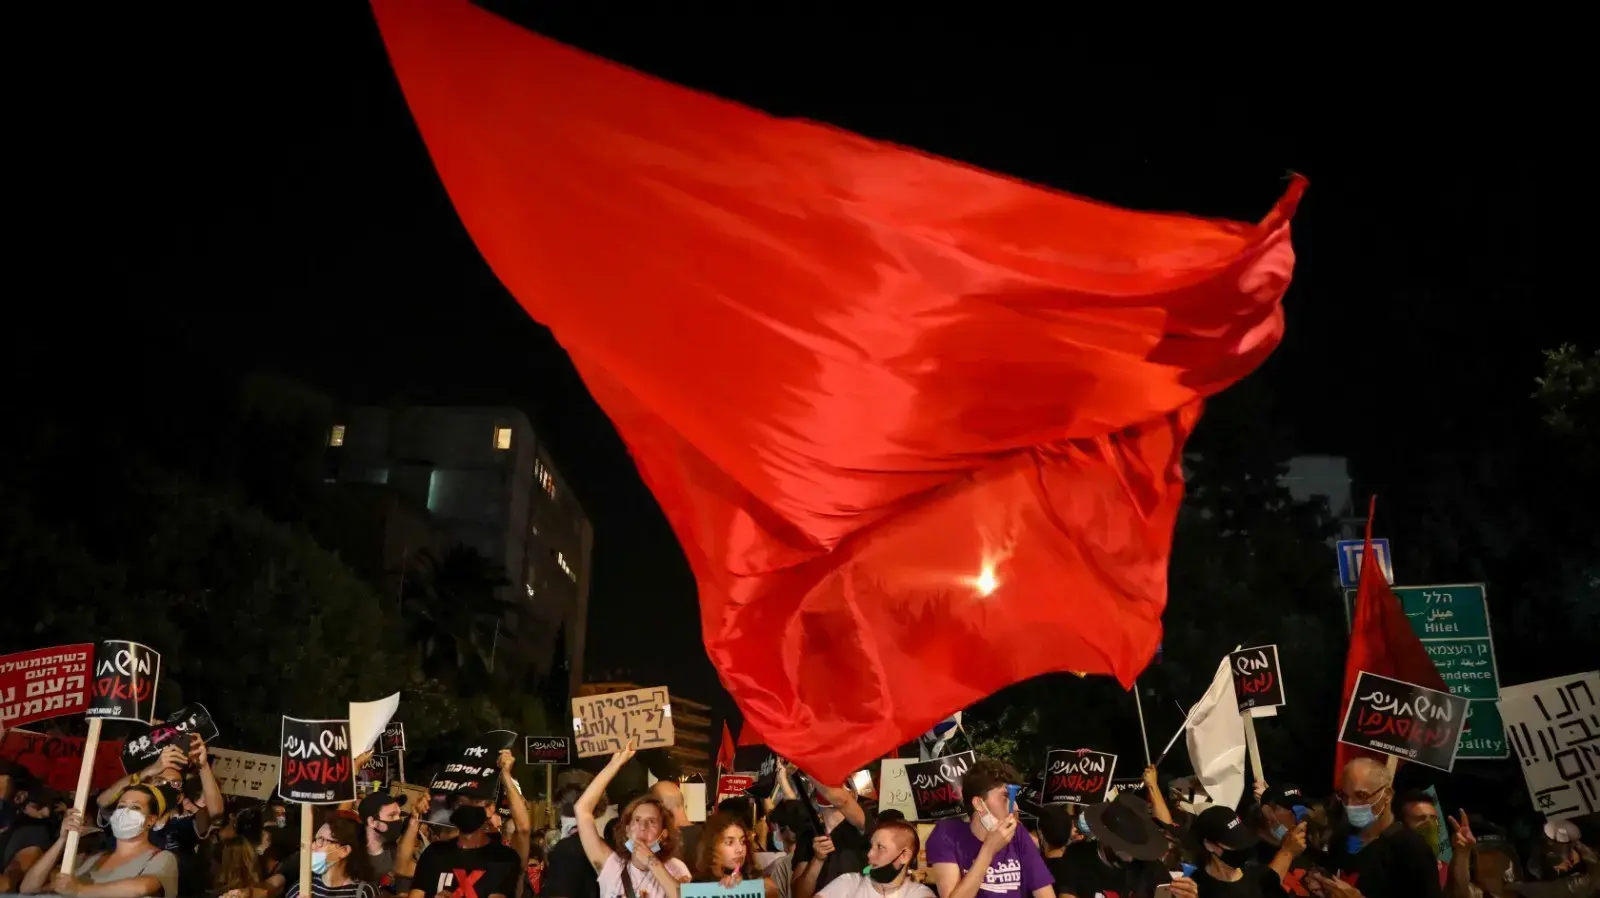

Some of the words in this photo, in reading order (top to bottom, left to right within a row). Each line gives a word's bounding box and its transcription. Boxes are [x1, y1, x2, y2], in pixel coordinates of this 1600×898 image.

[1422, 591, 1453, 604] הלל
[1425, 622, 1459, 633] Hilel
[25, 668, 58, 680] העם
[62, 663, 86, 673] נגד
[1440, 671, 1491, 681] endence
[26, 675, 85, 698] העם
[1448, 685, 1472, 694] ark
[0, 692, 84, 721] הממש
[1457, 739, 1502, 752] pality
